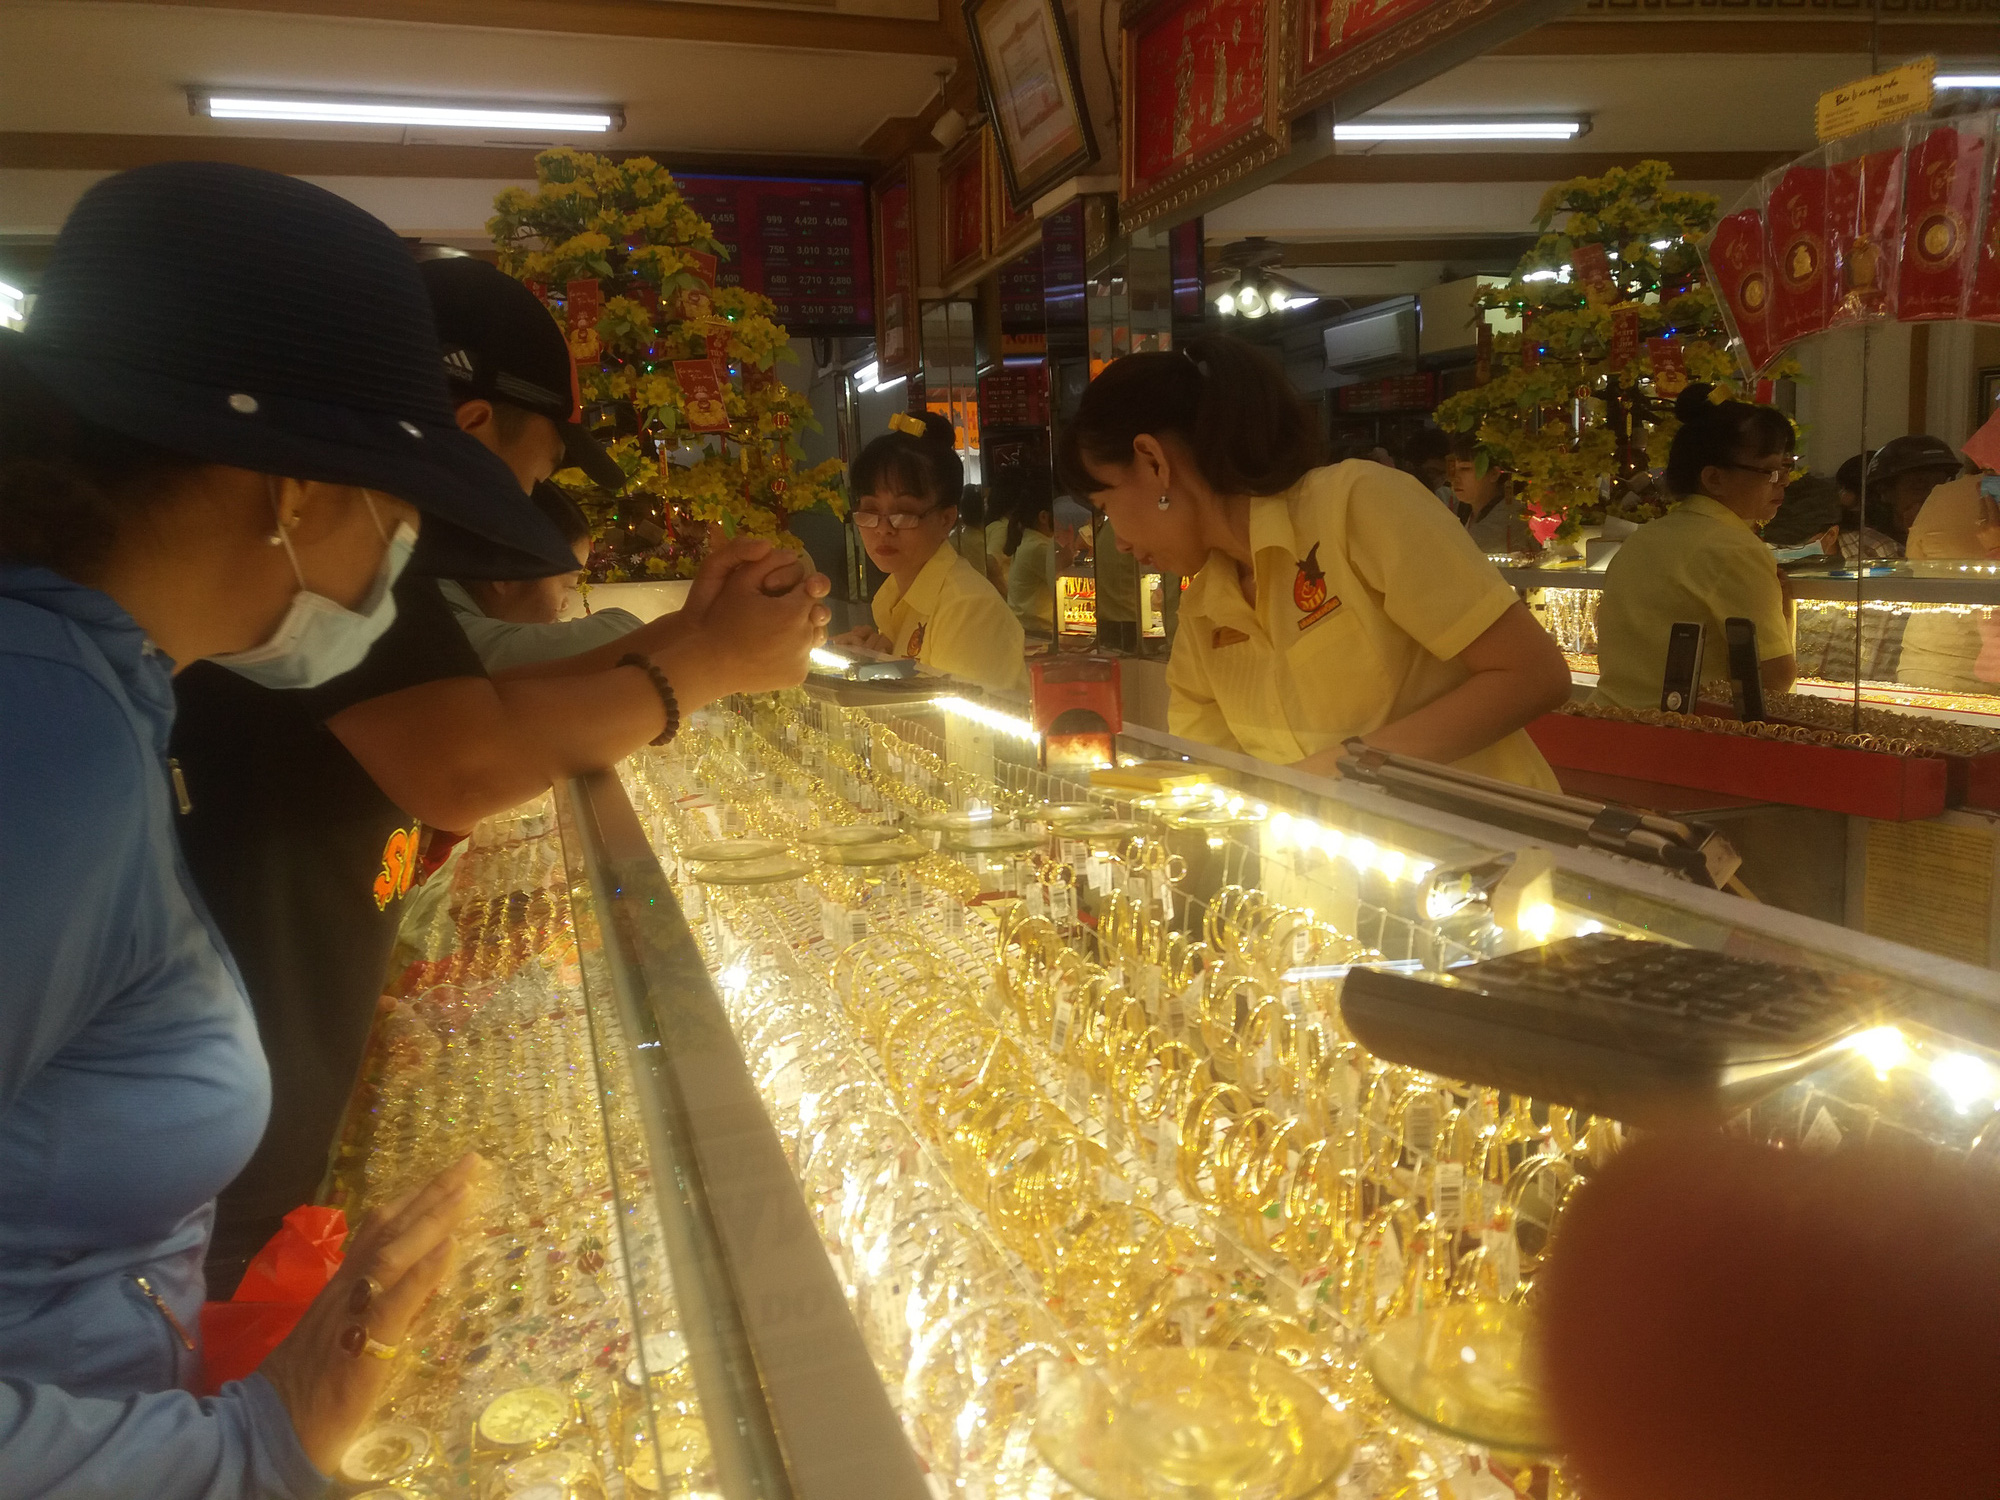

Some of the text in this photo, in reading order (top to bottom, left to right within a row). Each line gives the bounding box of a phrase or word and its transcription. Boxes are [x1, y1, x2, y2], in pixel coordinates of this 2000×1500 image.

[711, 213, 735, 224] 4,455
[766, 215, 848, 227] 999 4,420 4,450
[769, 245, 850, 257] 750 3,010 3,210
[771, 275, 852, 287] 680 2,710 2,880
[801, 305, 854, 316] 2,610 2,780
[445, 366, 473, 382] didas
